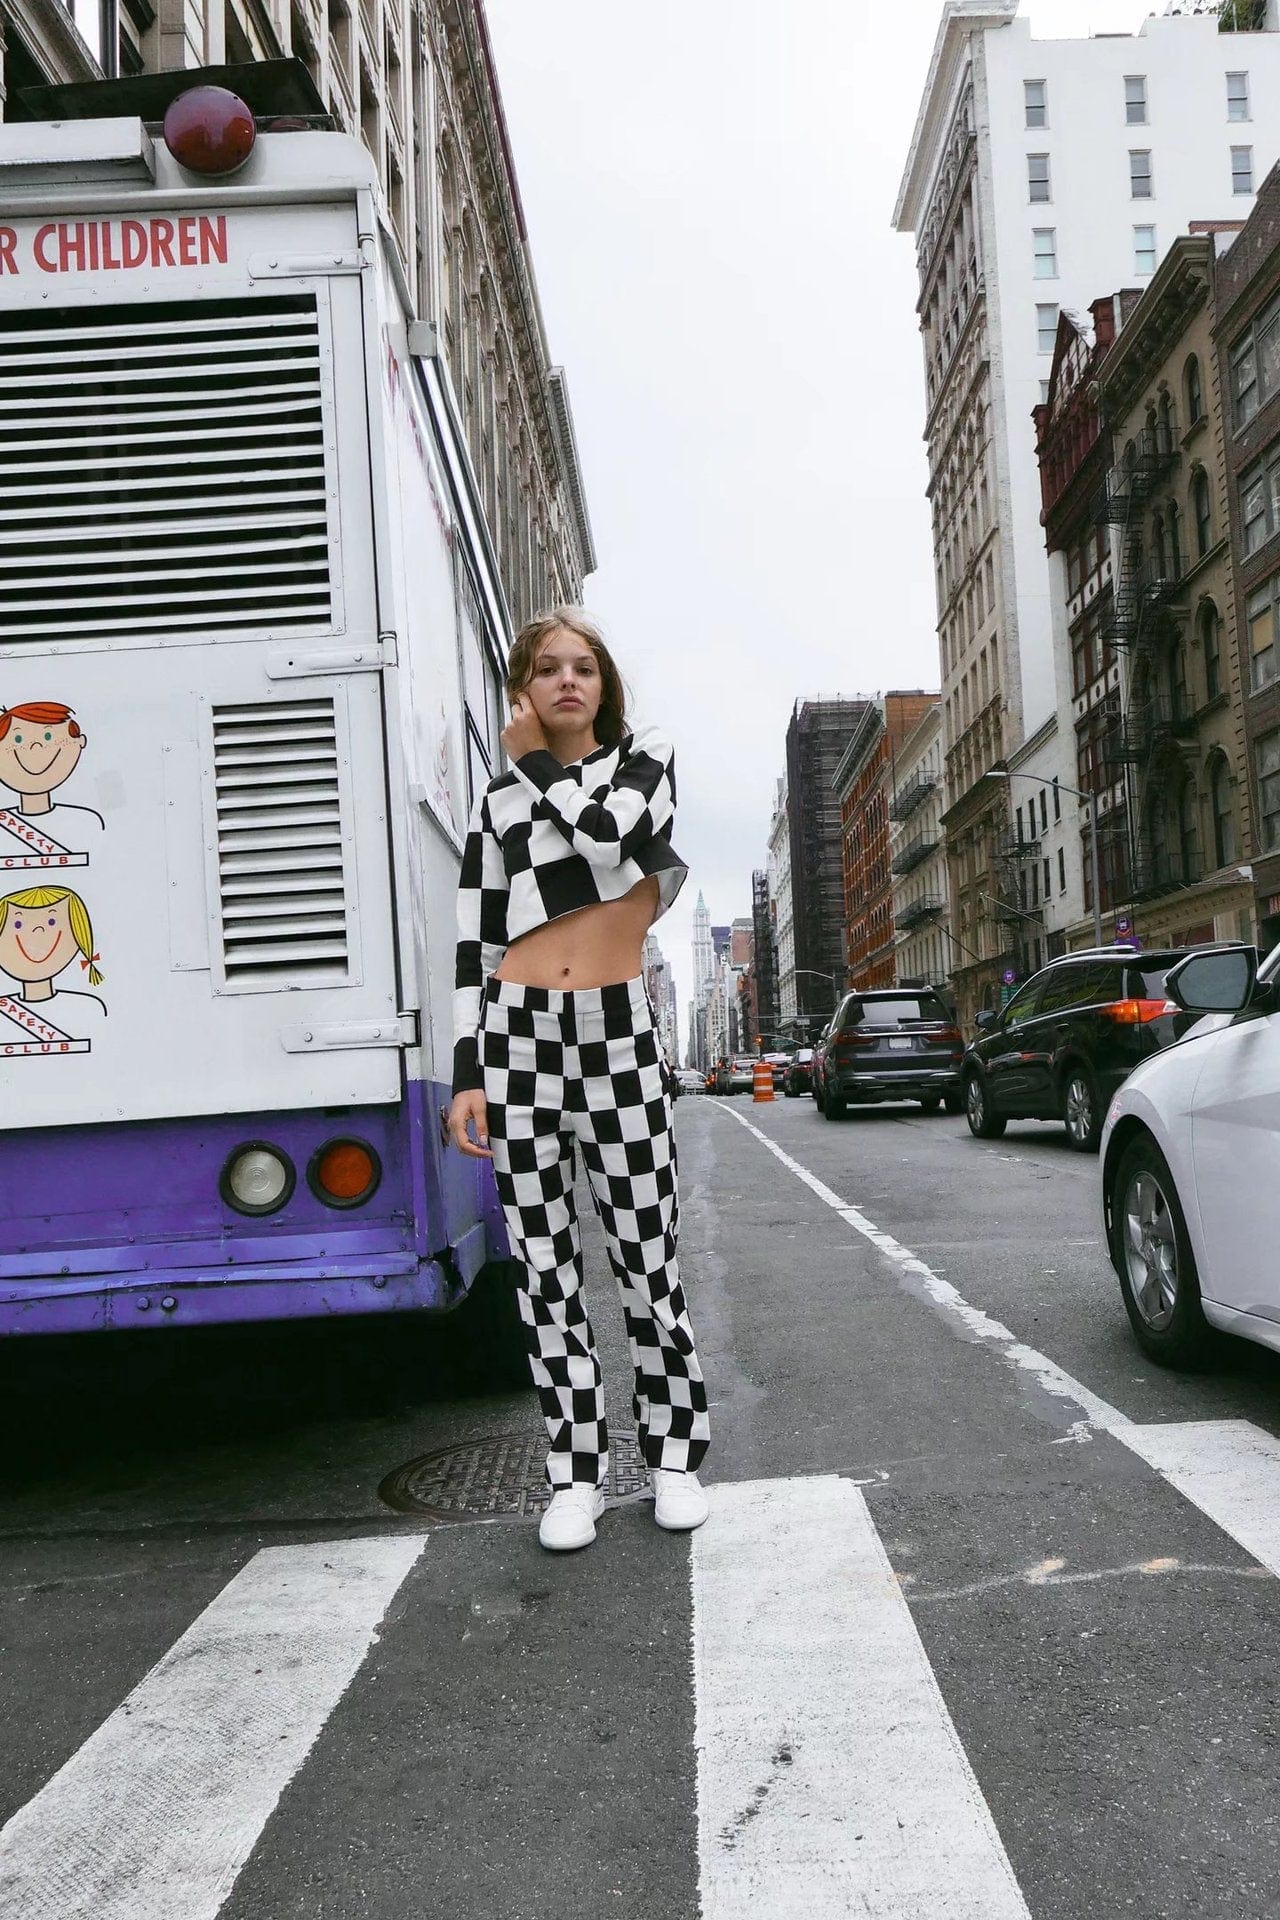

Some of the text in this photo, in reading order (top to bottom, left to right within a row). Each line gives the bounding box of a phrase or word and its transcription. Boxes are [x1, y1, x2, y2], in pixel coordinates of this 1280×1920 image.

[33, 215, 228, 273] CHILDREN
[0, 812, 54, 853] SAFETY
[5, 856, 68, 867] CLUB
[0, 998, 56, 1040] SAFETY
[5, 1043, 69, 1054] CLUB
